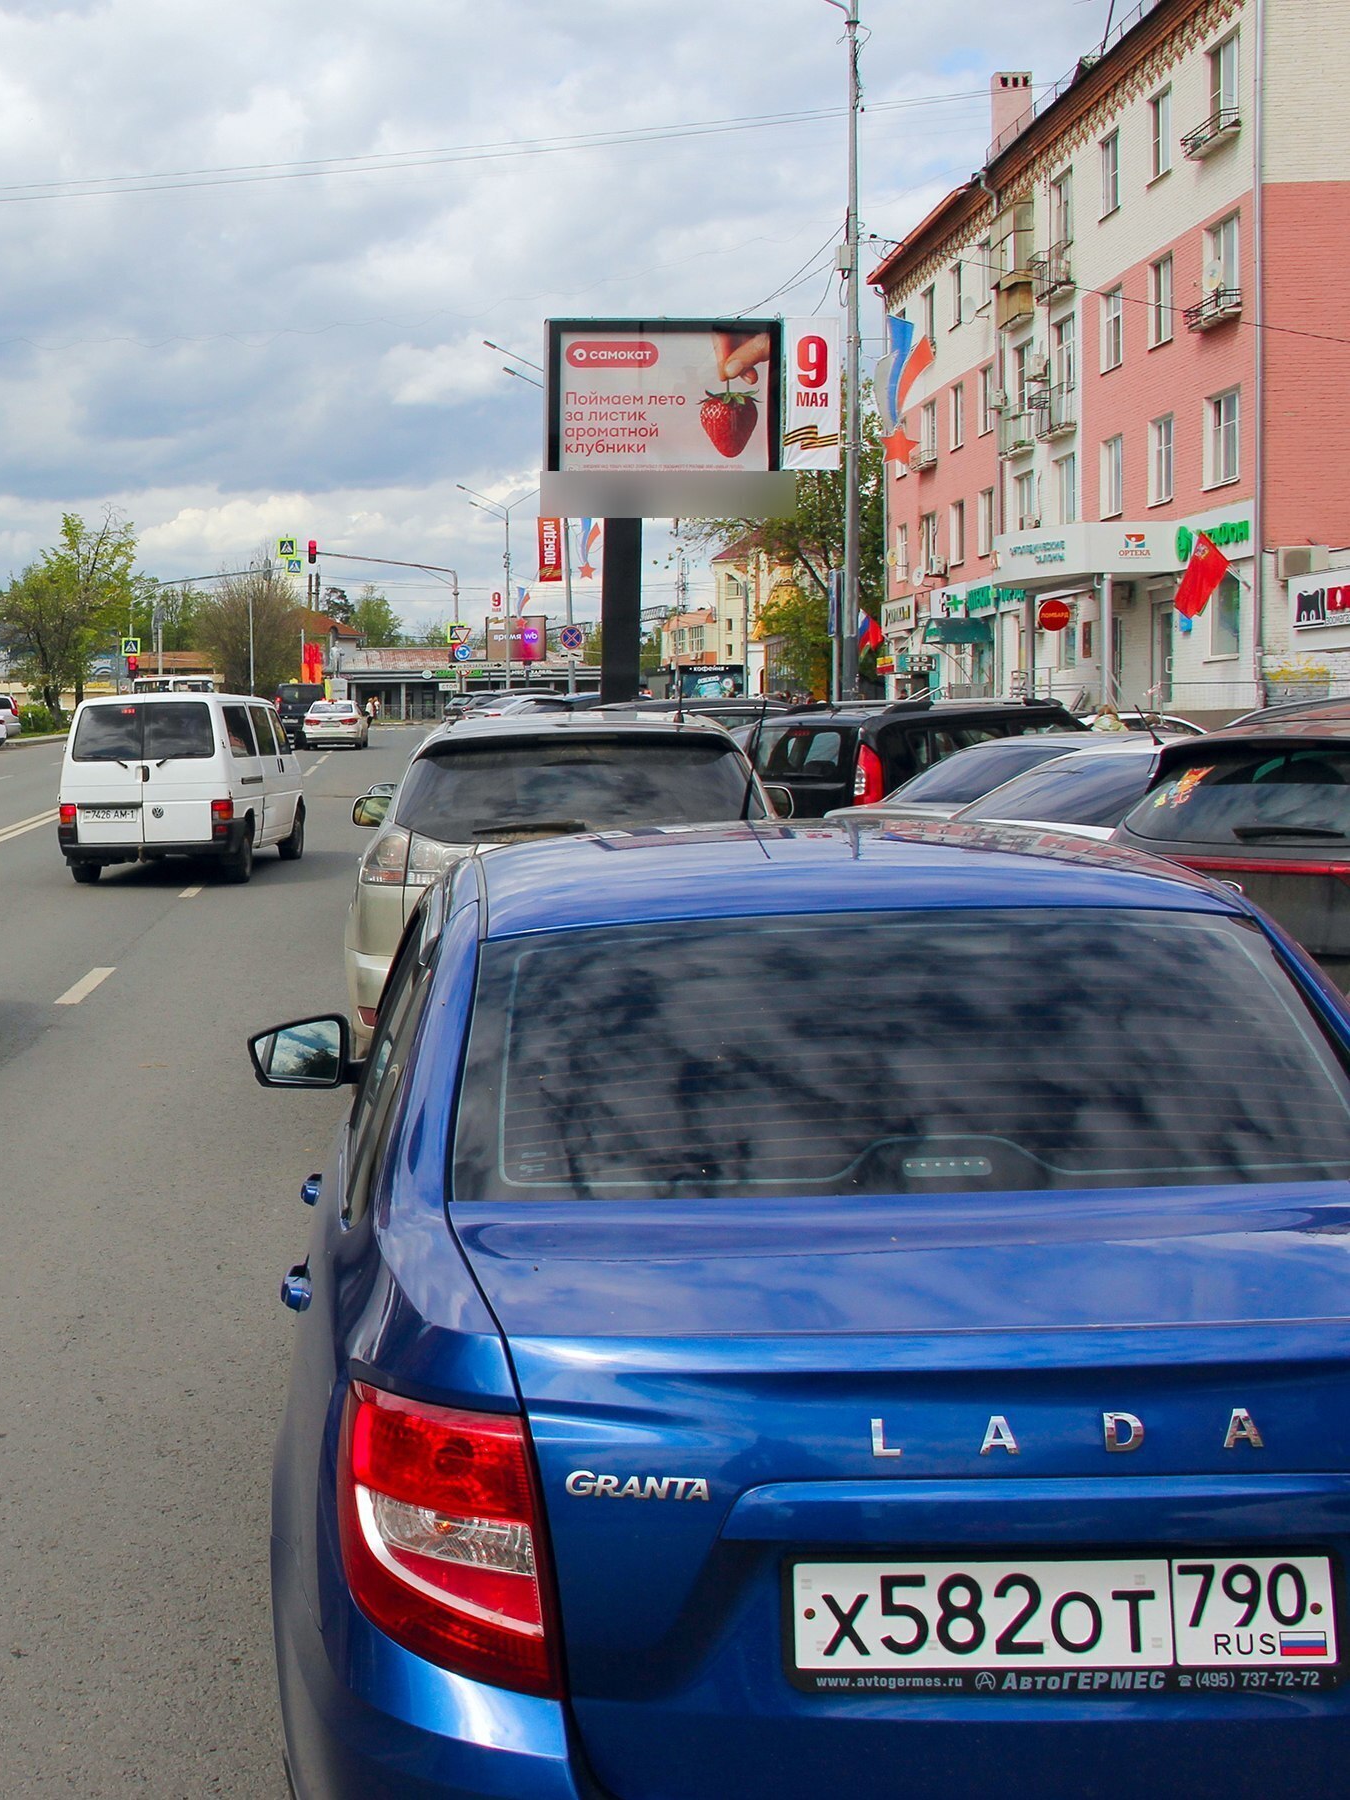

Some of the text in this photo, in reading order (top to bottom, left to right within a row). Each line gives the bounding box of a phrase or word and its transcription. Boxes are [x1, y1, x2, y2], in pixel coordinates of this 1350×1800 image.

[589, 349, 652, 361] самокат
[797, 335, 828, 389] 9
[564, 391, 686, 406] Поймаем лето
[796, 391, 829, 408] МАЯ
[564, 410, 647, 422] за листик
[564, 422, 659, 440] ароматной
[564, 439, 646, 457] клубники
[542, 520, 557, 565] ПОБЕДА!
[91, 809, 111, 819] 7426
[871, 1407, 1264, 1457] LADA
[564, 1469, 711, 1501] GRANTA
[820, 1562, 1307, 1656] Х582ОТ 790
[1213, 1633, 1277, 1656] RUS
[815, 1674, 963, 1689] www.avtogermes.ru
[1195, 1671, 1320, 1687] (495) 737-72-72
